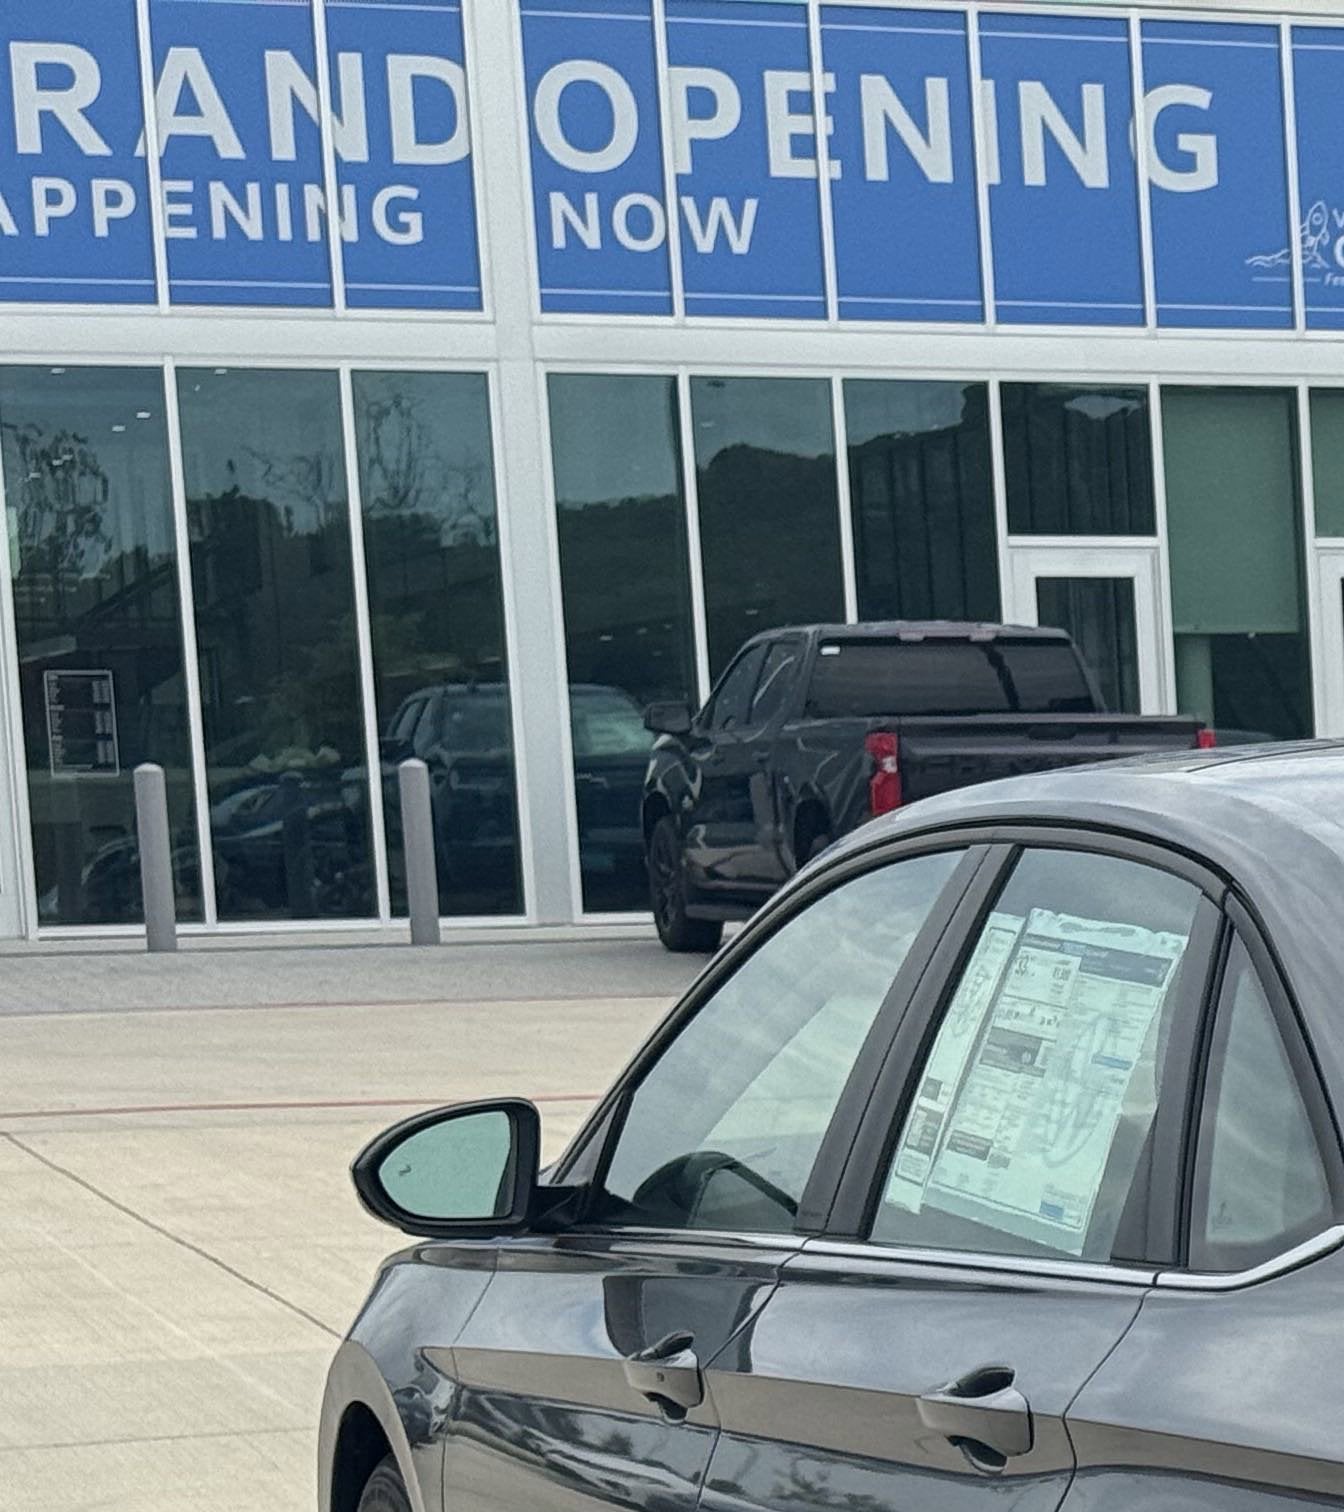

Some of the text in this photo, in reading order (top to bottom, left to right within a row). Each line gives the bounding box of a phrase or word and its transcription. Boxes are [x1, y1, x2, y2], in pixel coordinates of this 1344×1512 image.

[534, 60, 1219, 193] OPENING
[0, 176, 424, 246] PPENING
[549, 191, 758, 254] NOW
